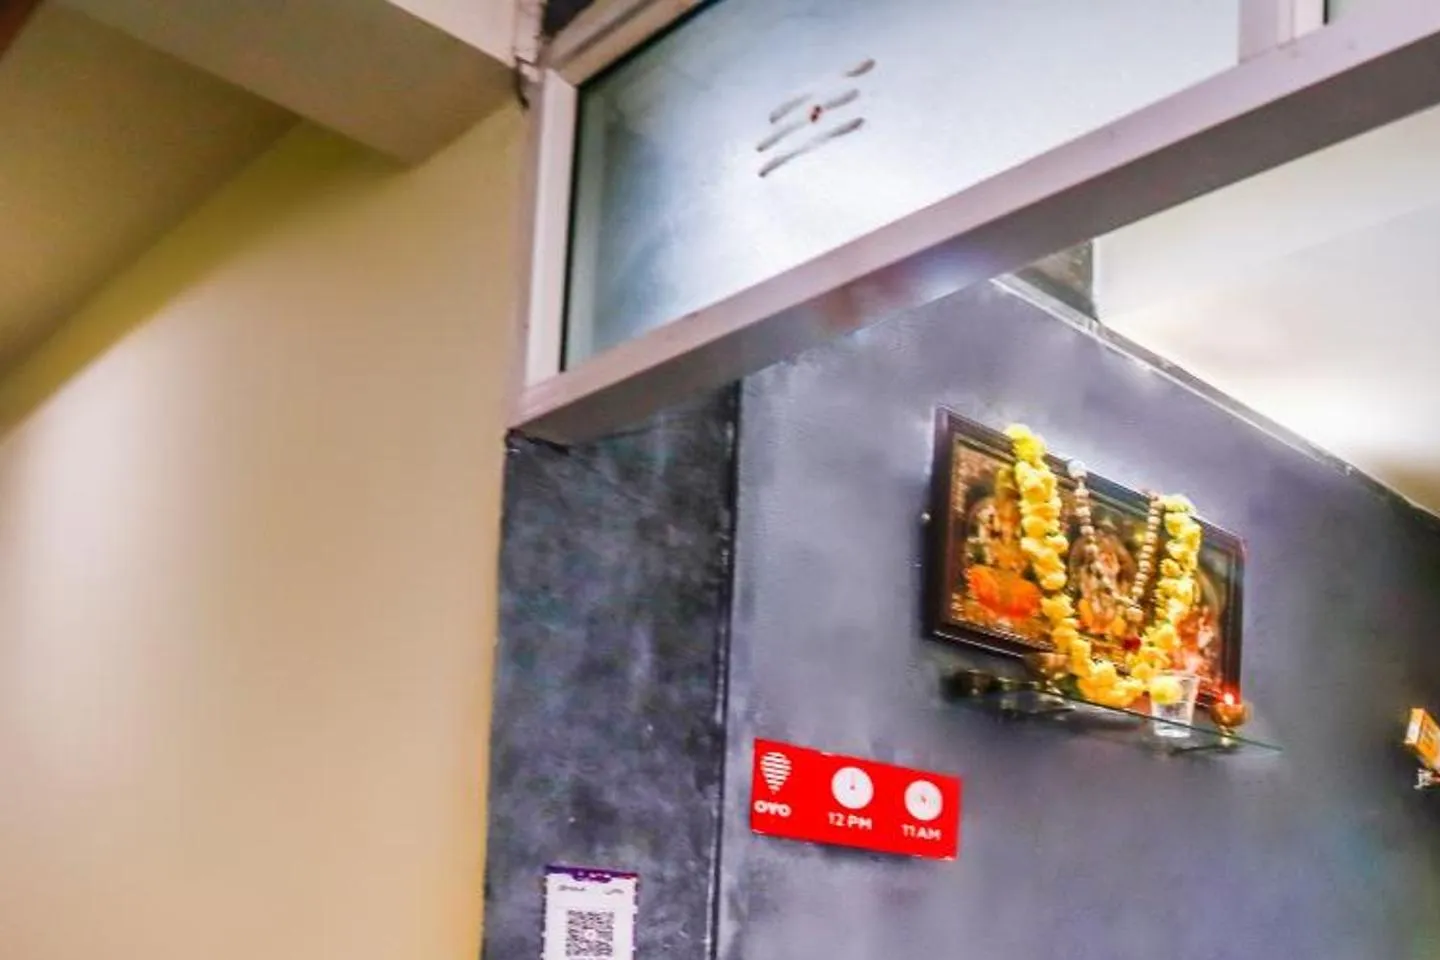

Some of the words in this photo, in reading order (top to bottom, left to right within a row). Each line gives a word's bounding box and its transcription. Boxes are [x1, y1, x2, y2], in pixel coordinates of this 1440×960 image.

[754, 800, 792, 816] OYO
[828, 812, 845, 827] 12
[848, 816, 873, 830] PM
